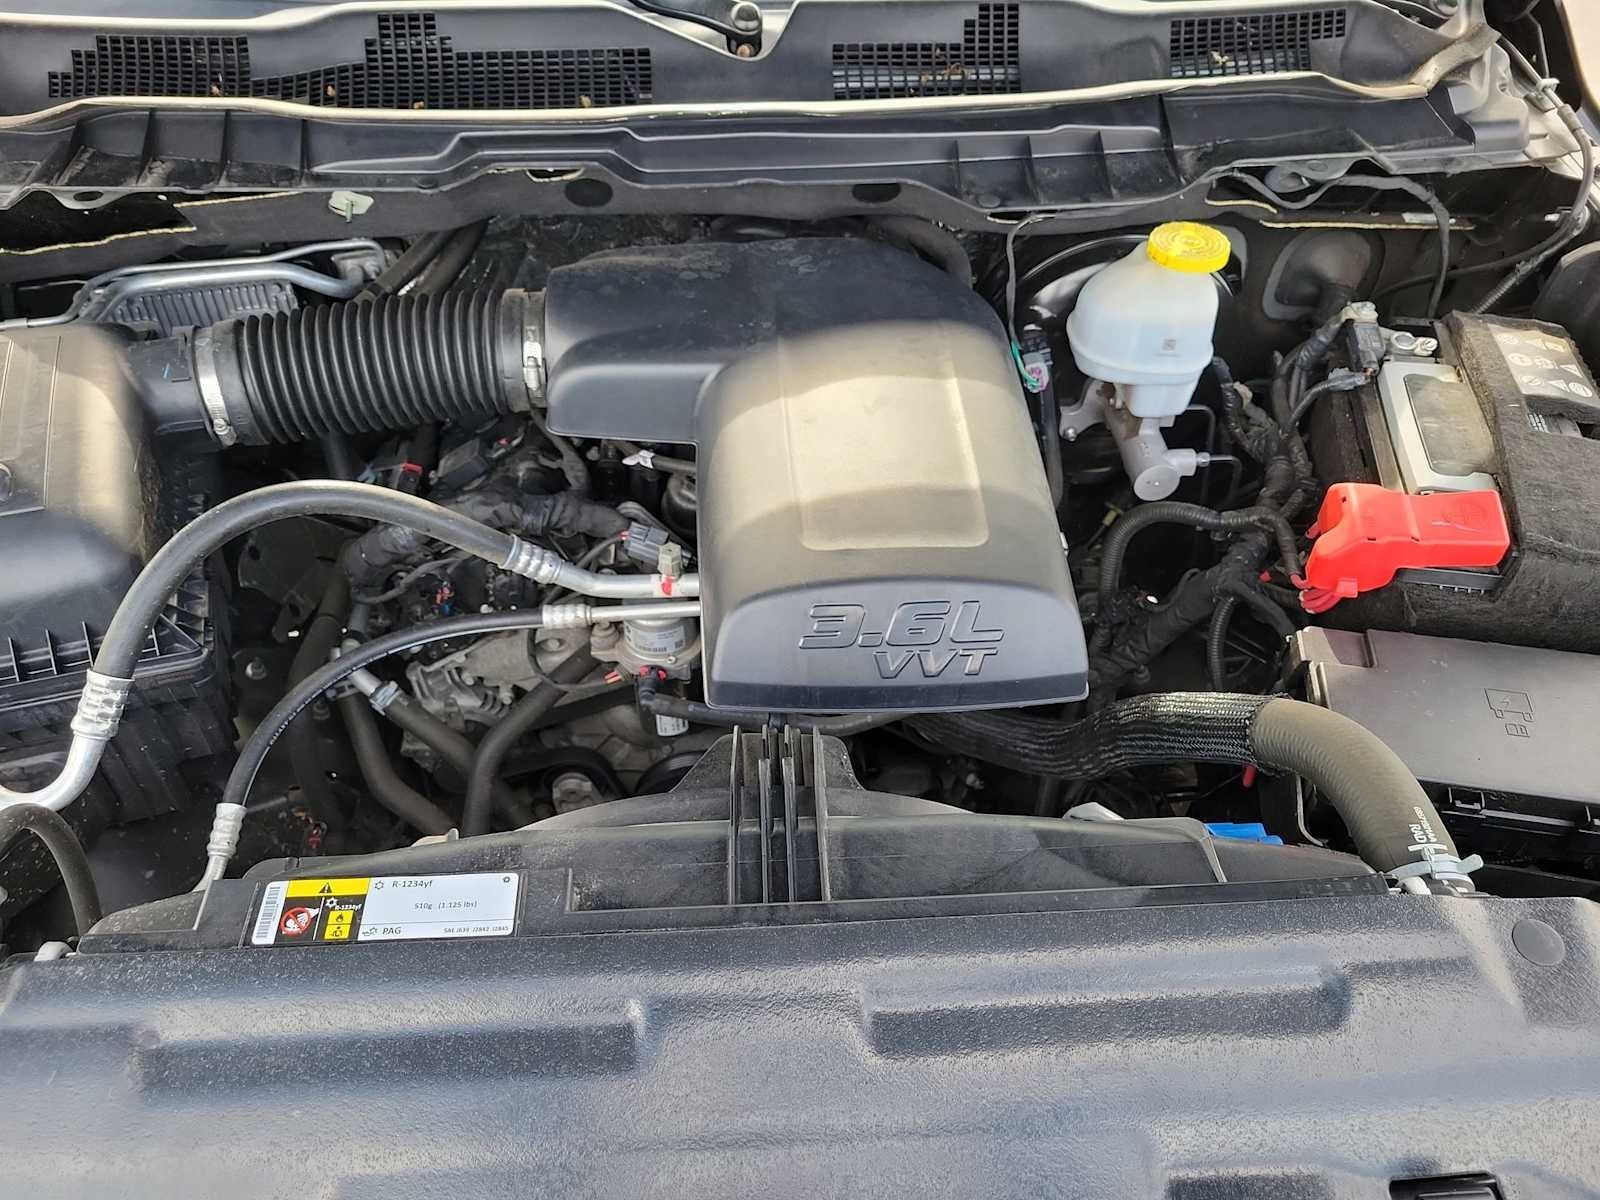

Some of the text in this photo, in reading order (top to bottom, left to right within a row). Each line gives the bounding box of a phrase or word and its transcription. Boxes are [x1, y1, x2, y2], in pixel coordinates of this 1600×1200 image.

[799, 600, 1005, 649] 3.6L
[873, 647, 998, 679] VVT
[1408, 823, 1427, 843] RAD
[392, 880, 432, 888] R-1234yf
[414, 902, 432, 910] 510g
[382, 927, 401, 935] PAG
